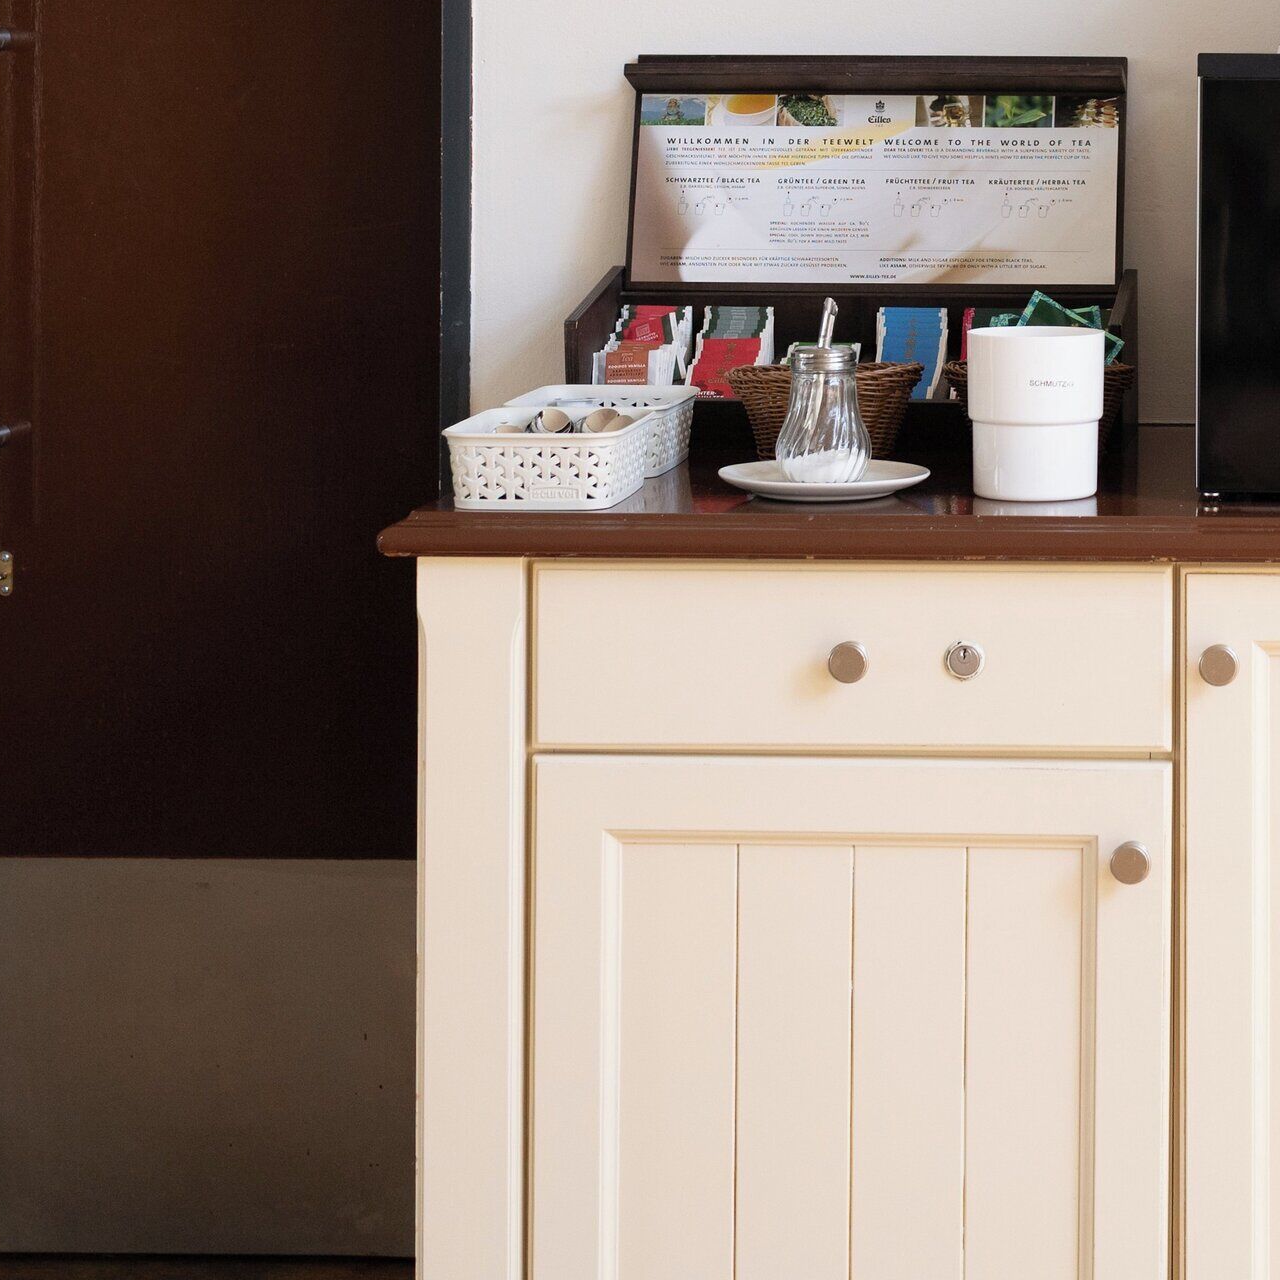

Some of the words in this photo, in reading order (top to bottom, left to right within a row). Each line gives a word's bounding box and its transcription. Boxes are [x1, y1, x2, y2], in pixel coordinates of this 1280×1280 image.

[667, 137, 749, 145] WILLKOMMEN
[788, 138, 810, 146] DER
[823, 138, 874, 146] TEEWELT
[884, 138, 939, 146] WELCOME
